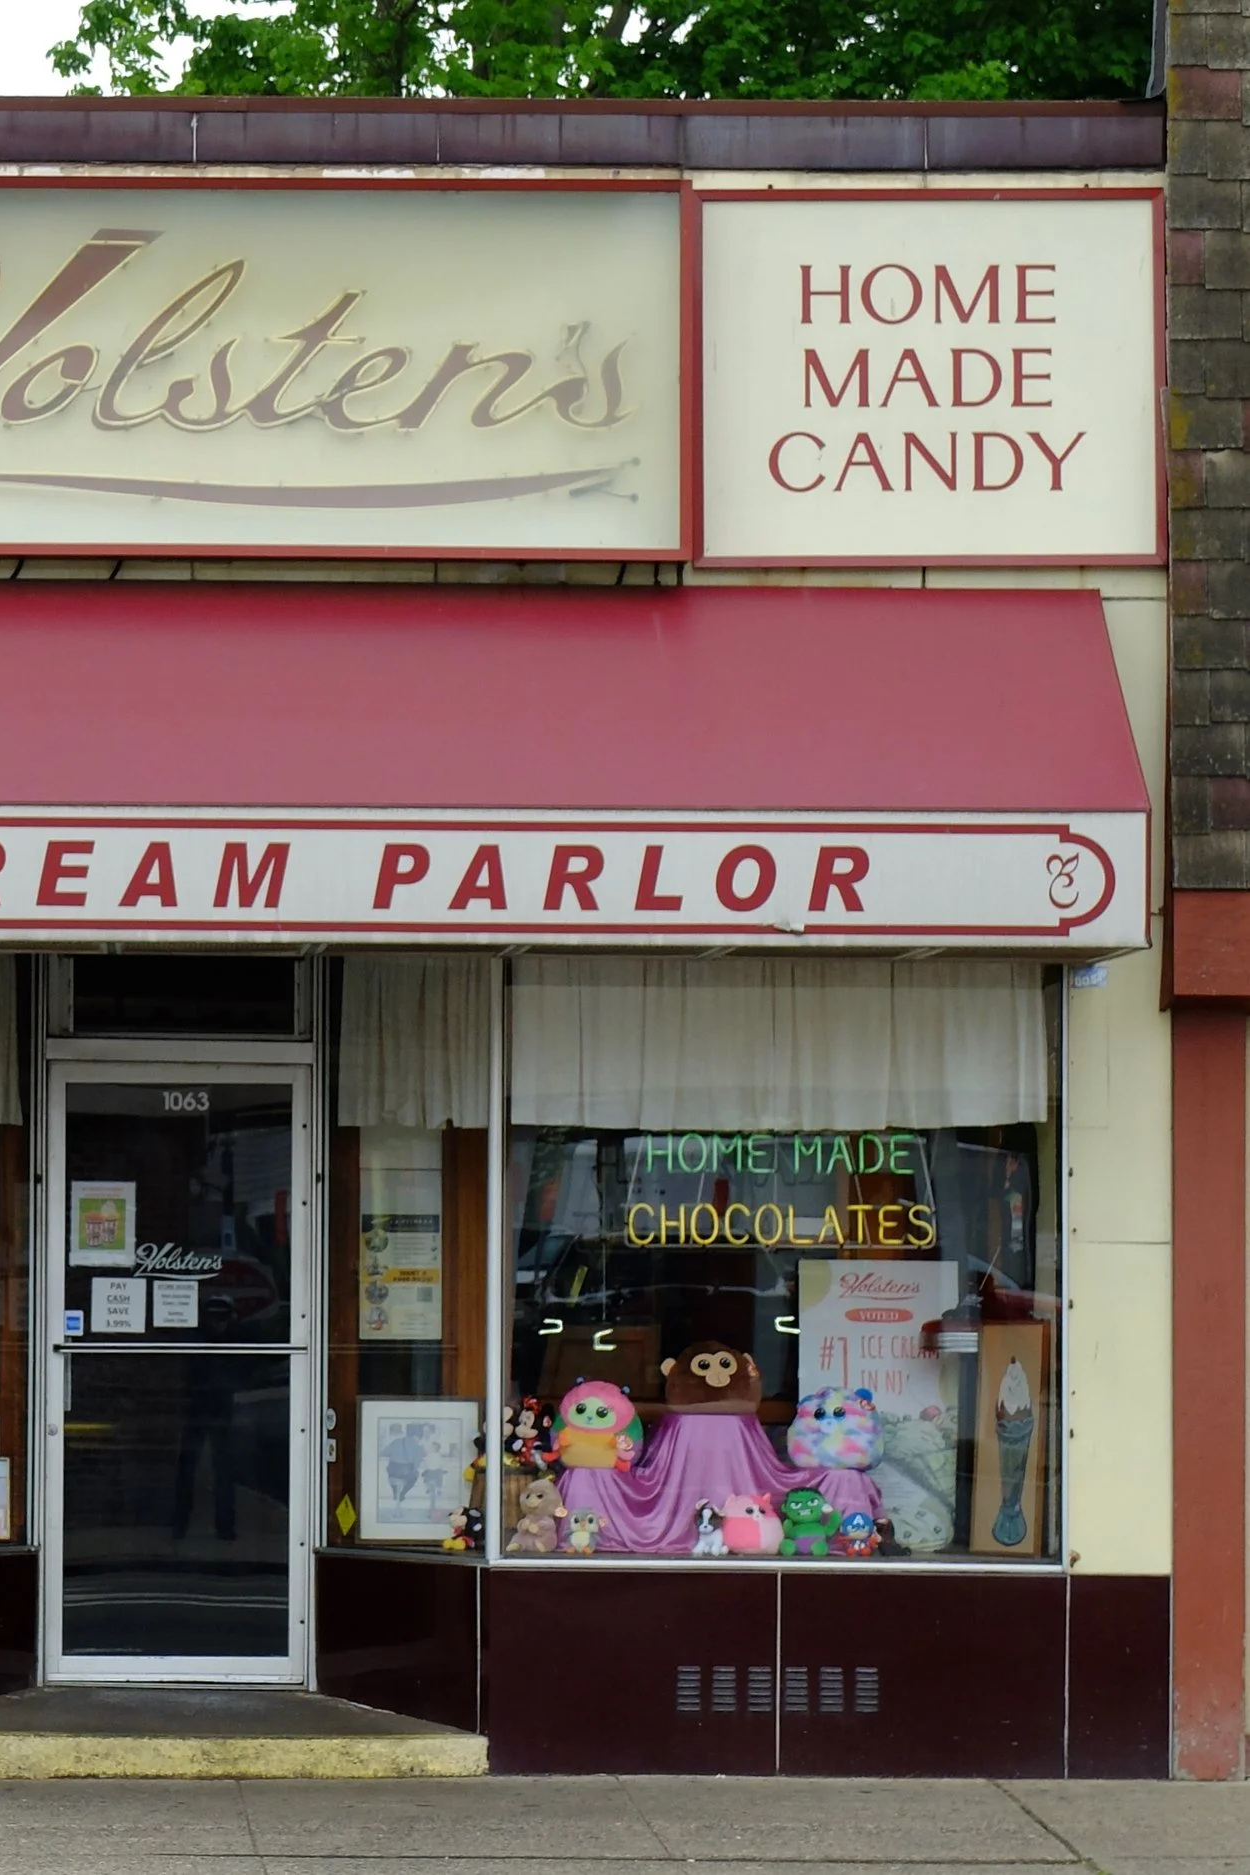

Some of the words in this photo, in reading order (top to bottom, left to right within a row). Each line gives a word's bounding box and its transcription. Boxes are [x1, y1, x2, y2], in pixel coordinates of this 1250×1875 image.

[799, 263, 1057, 325] HOME
[803, 348, 1054, 409] MADE
[767, 431, 1088, 493] CANDY
[371, 842, 871, 913] PARLOR
[162, 1091, 210, 1111] 1063
[644, 1131, 776, 1174] HOME
[793, 1132, 917, 1175] MADE
[628, 1202, 935, 1246] CHOCOLATES
[134, 1243, 223, 1279] Holsten's
[106, 1294, 130, 1303] CASH
[110, 1282, 128, 1290] PAY
[838, 1271, 922, 1299] Holsten's
[107, 1307, 129, 1316] SAVE
[858, 1310, 899, 1321] VOTED
[819, 1335, 849, 1390] #1
[860, 1335, 884, 1360] ICE
[891, 1335, 940, 1360] CREAM
[860, 1369, 878, 1393] IN
[885, 1369, 903, 1395] NJ
[853, 1514, 865, 1525] A
